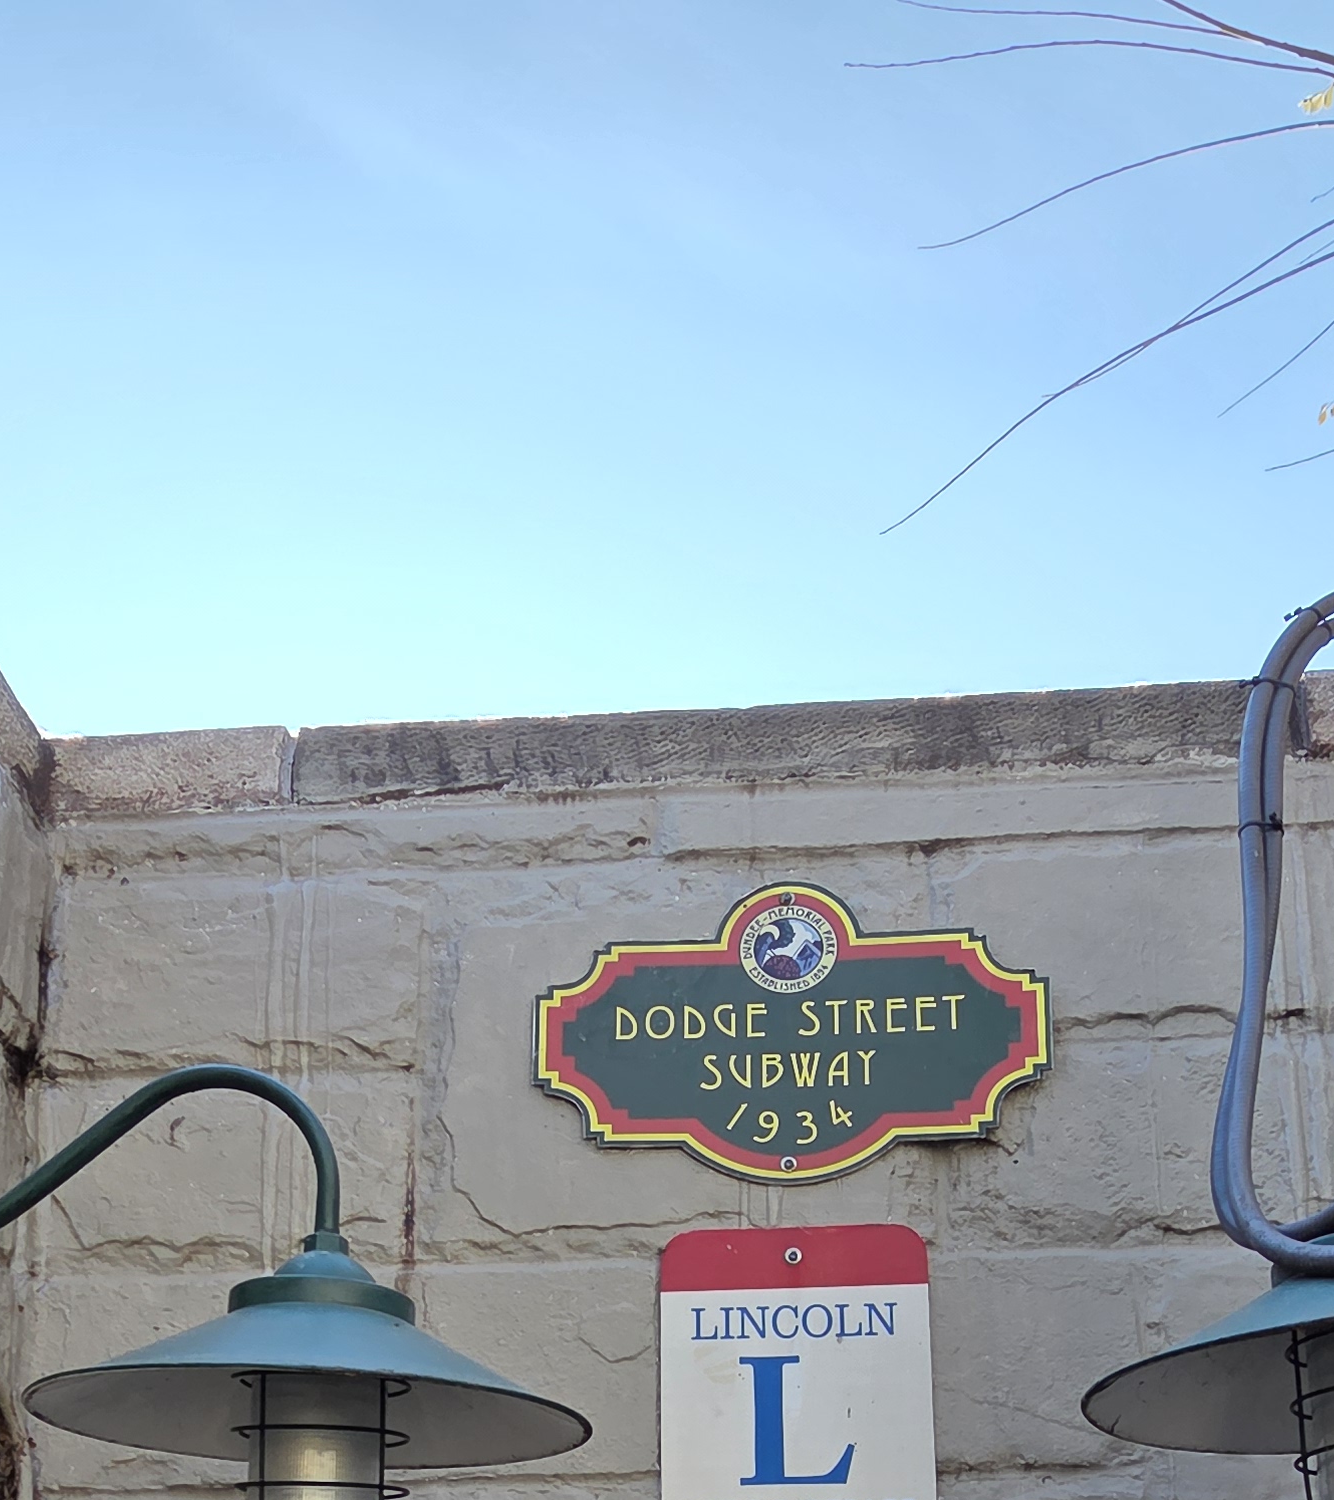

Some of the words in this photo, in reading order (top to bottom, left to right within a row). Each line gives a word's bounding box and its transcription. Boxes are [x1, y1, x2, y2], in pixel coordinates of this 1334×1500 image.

[822, 929, 835, 956] PARK
[749, 966, 810, 991] ESTABLISHED
[811, 965, 829, 982] 1894
[614, 1002, 769, 1041] DODGE
[798, 994, 966, 1037] STREET
[699, 1049, 878, 1091] SUBWAY
[725, 1099, 854, 1145] 1934
[690, 1301, 898, 1341] LINCOLN
[738, 1354, 856, 1486] L
